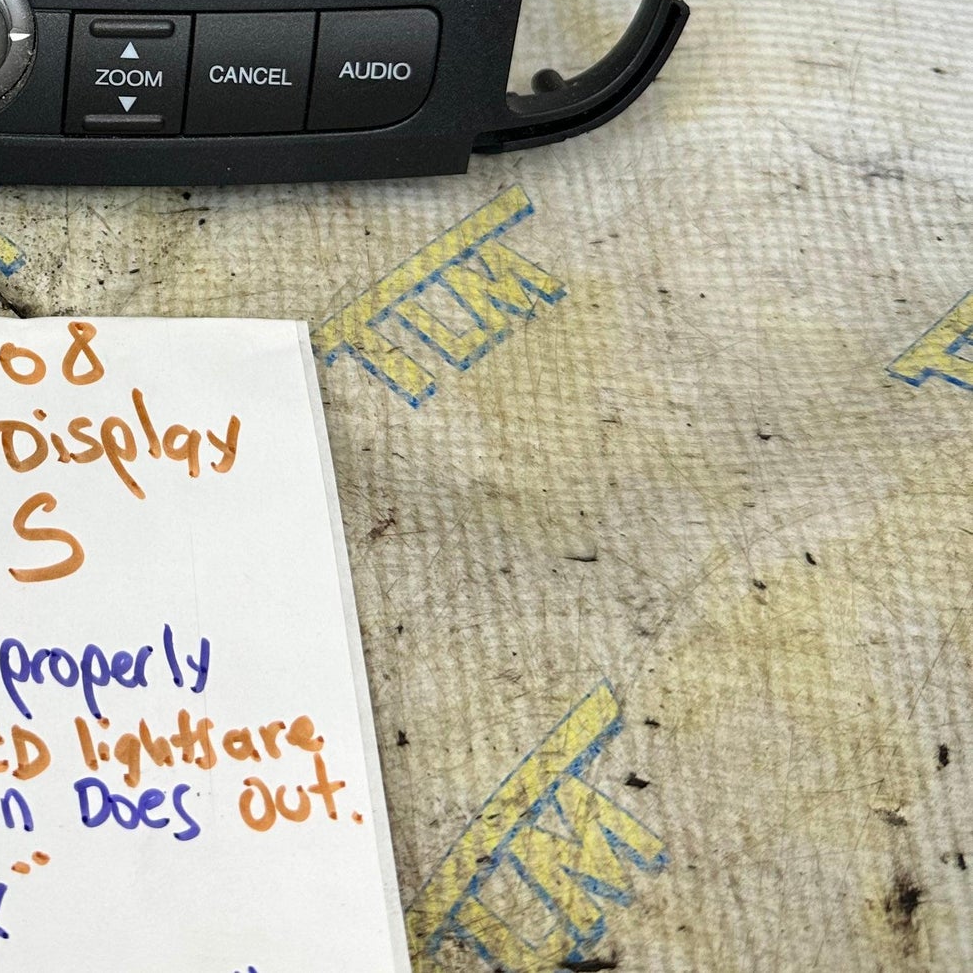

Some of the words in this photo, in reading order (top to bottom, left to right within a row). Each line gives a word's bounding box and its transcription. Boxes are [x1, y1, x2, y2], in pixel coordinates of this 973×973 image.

[94, 68, 163, 88] ZOOM
[208, 64, 293, 87] CANCEL
[337, 61, 412, 82] AUDIO
[310, 182, 569, 410] TLM
[7, 491, 86, 584] S
[221, 714, 326, 763] are
[73, 776, 202, 842] Does
